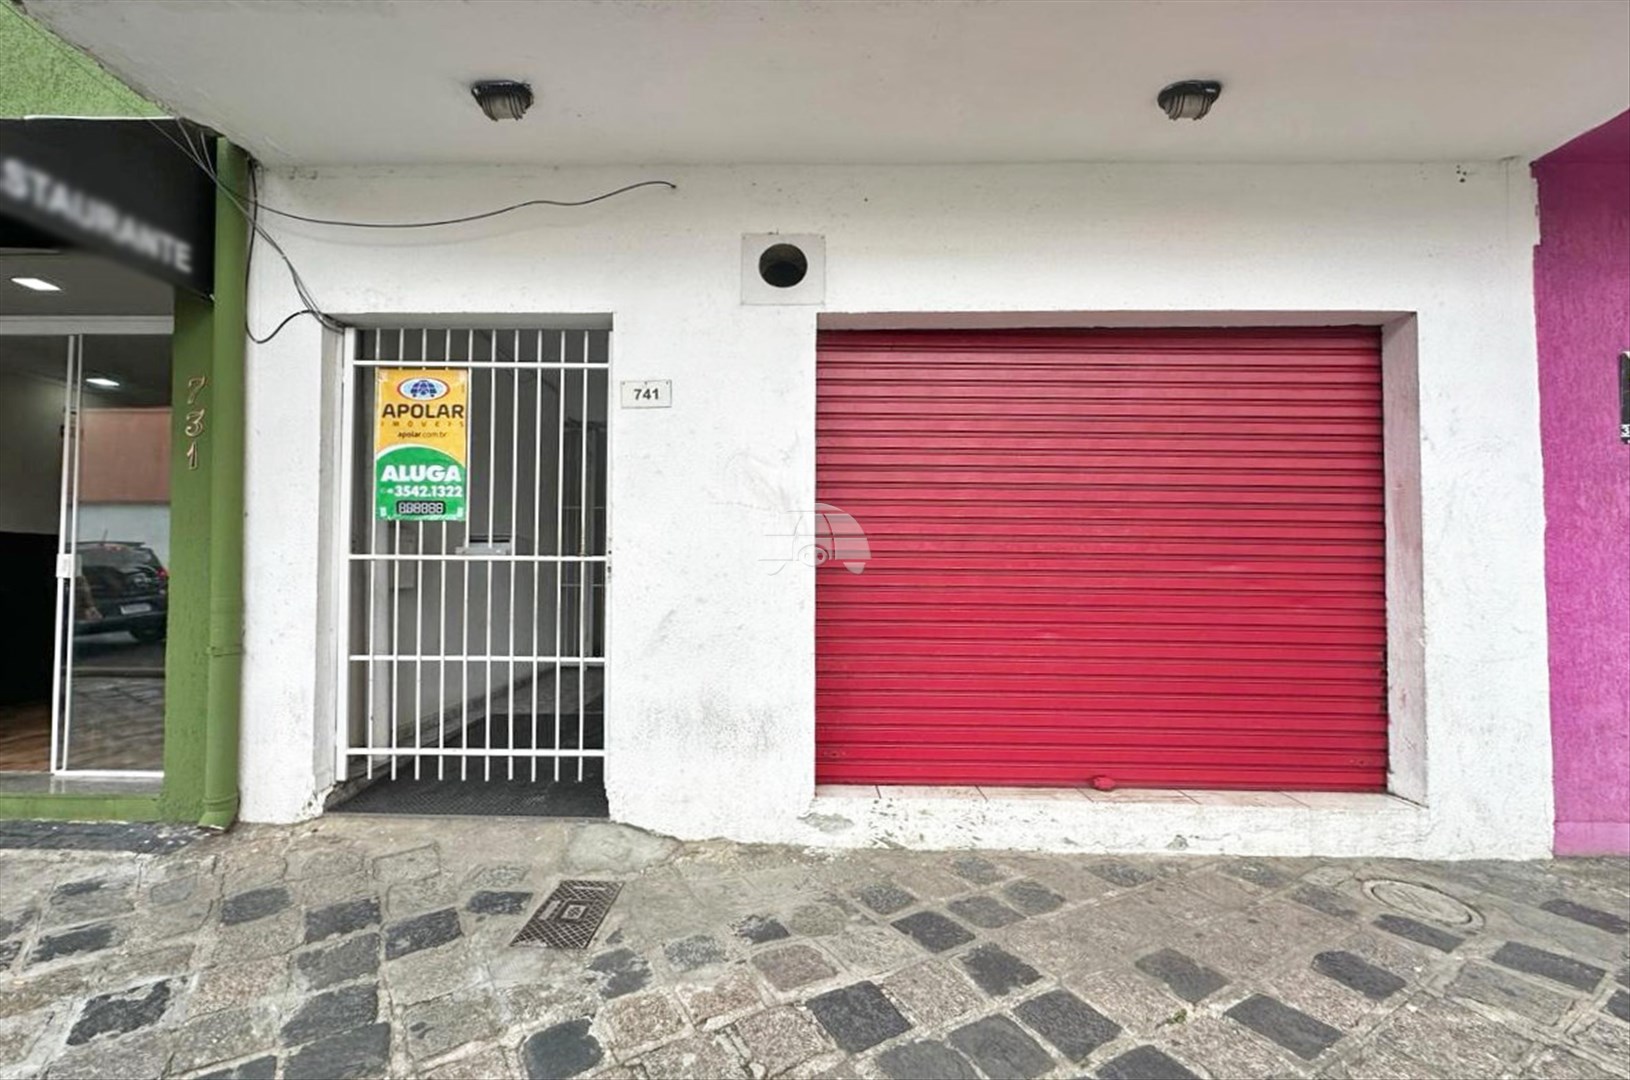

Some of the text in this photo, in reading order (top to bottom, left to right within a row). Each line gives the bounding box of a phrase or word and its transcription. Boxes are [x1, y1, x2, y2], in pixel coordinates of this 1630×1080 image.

[633, 388, 659, 400] 741
[382, 403, 464, 419] APOLAR
[185, 375, 205, 470] 731
[380, 464, 462, 482] ALUGA
